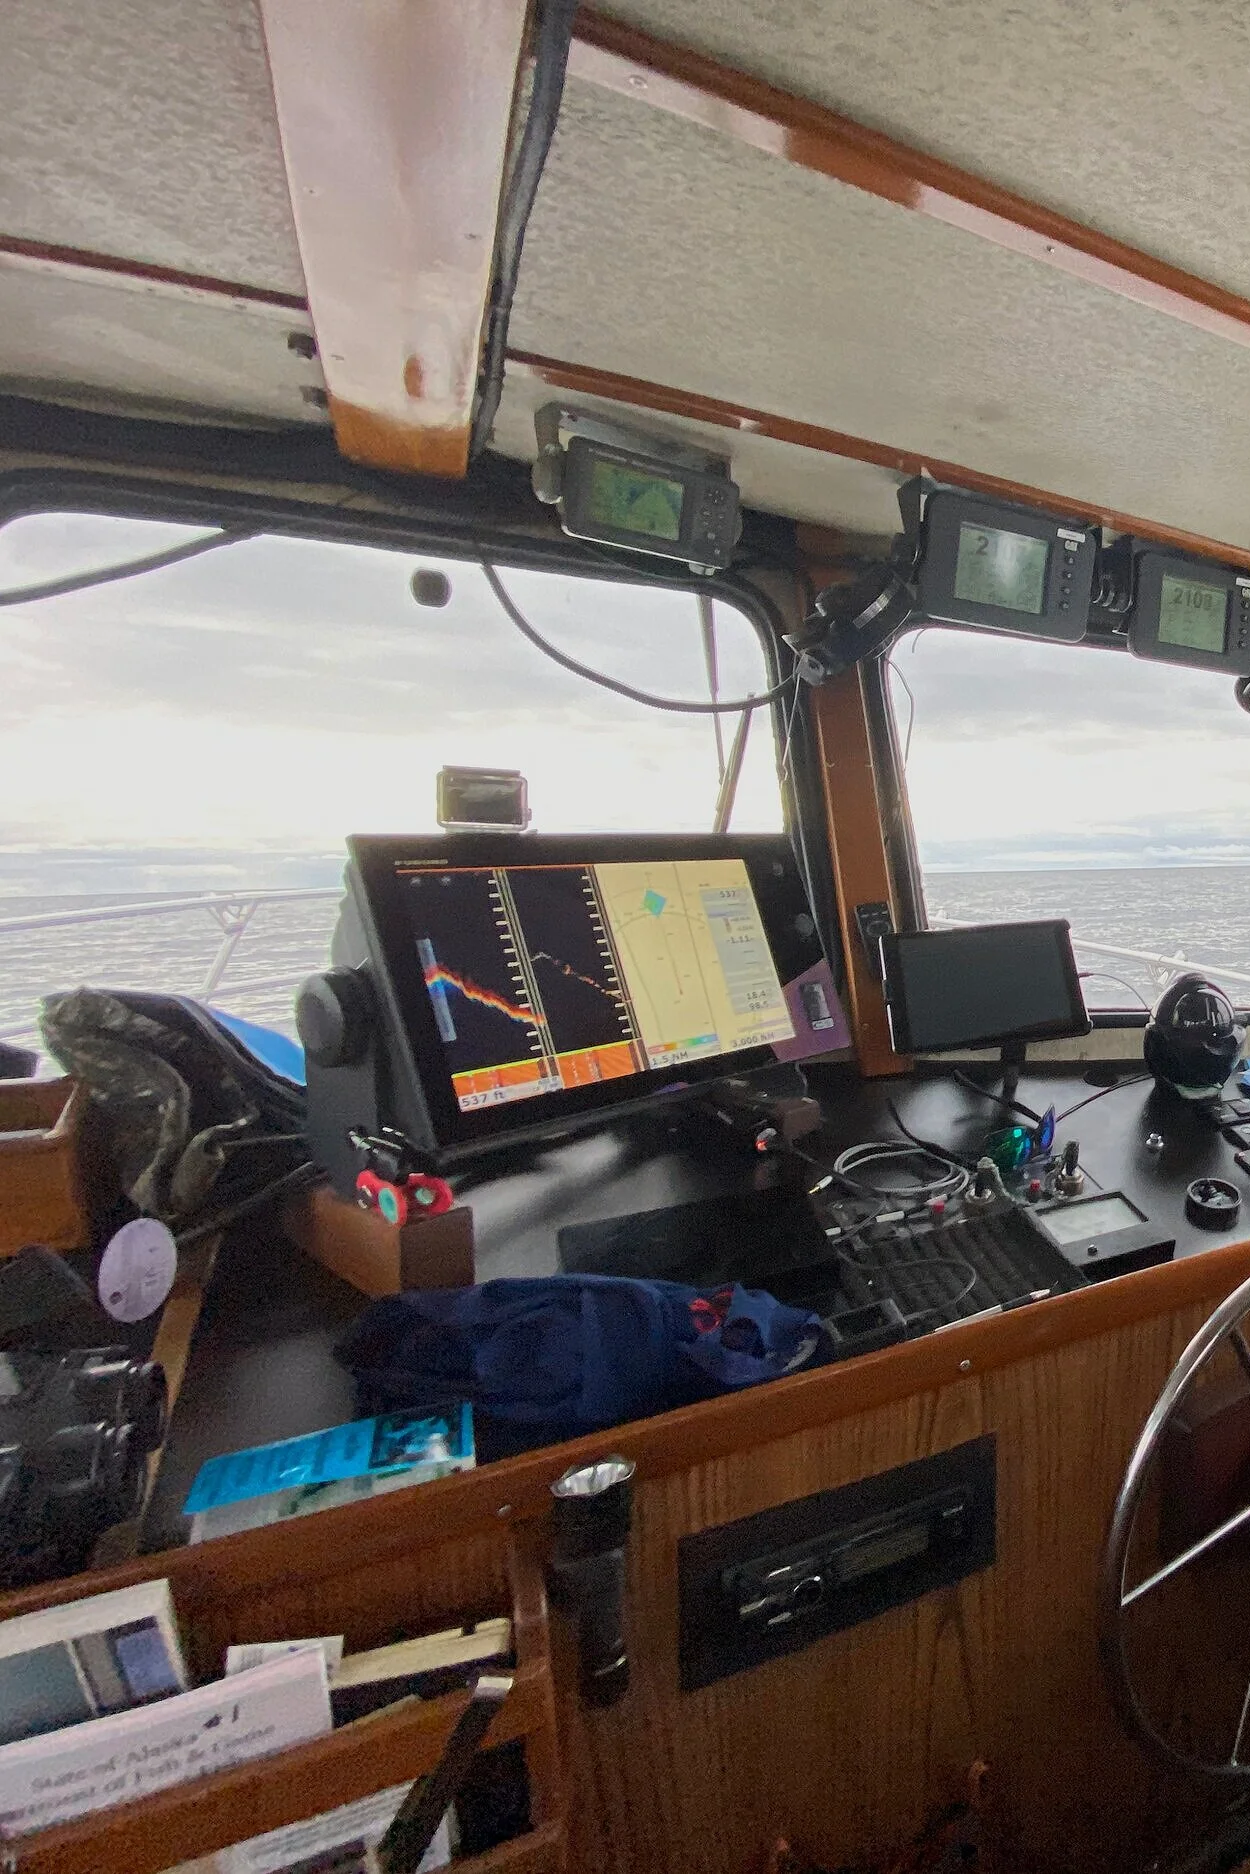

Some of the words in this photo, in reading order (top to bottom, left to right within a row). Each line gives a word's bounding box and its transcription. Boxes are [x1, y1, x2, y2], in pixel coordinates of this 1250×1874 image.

[461, 1093, 488, 1107] 537
[493, 1089, 505, 1101] ft
[31, 1769, 88, 1793] State
[125, 1732, 199, 1766] Alaska
